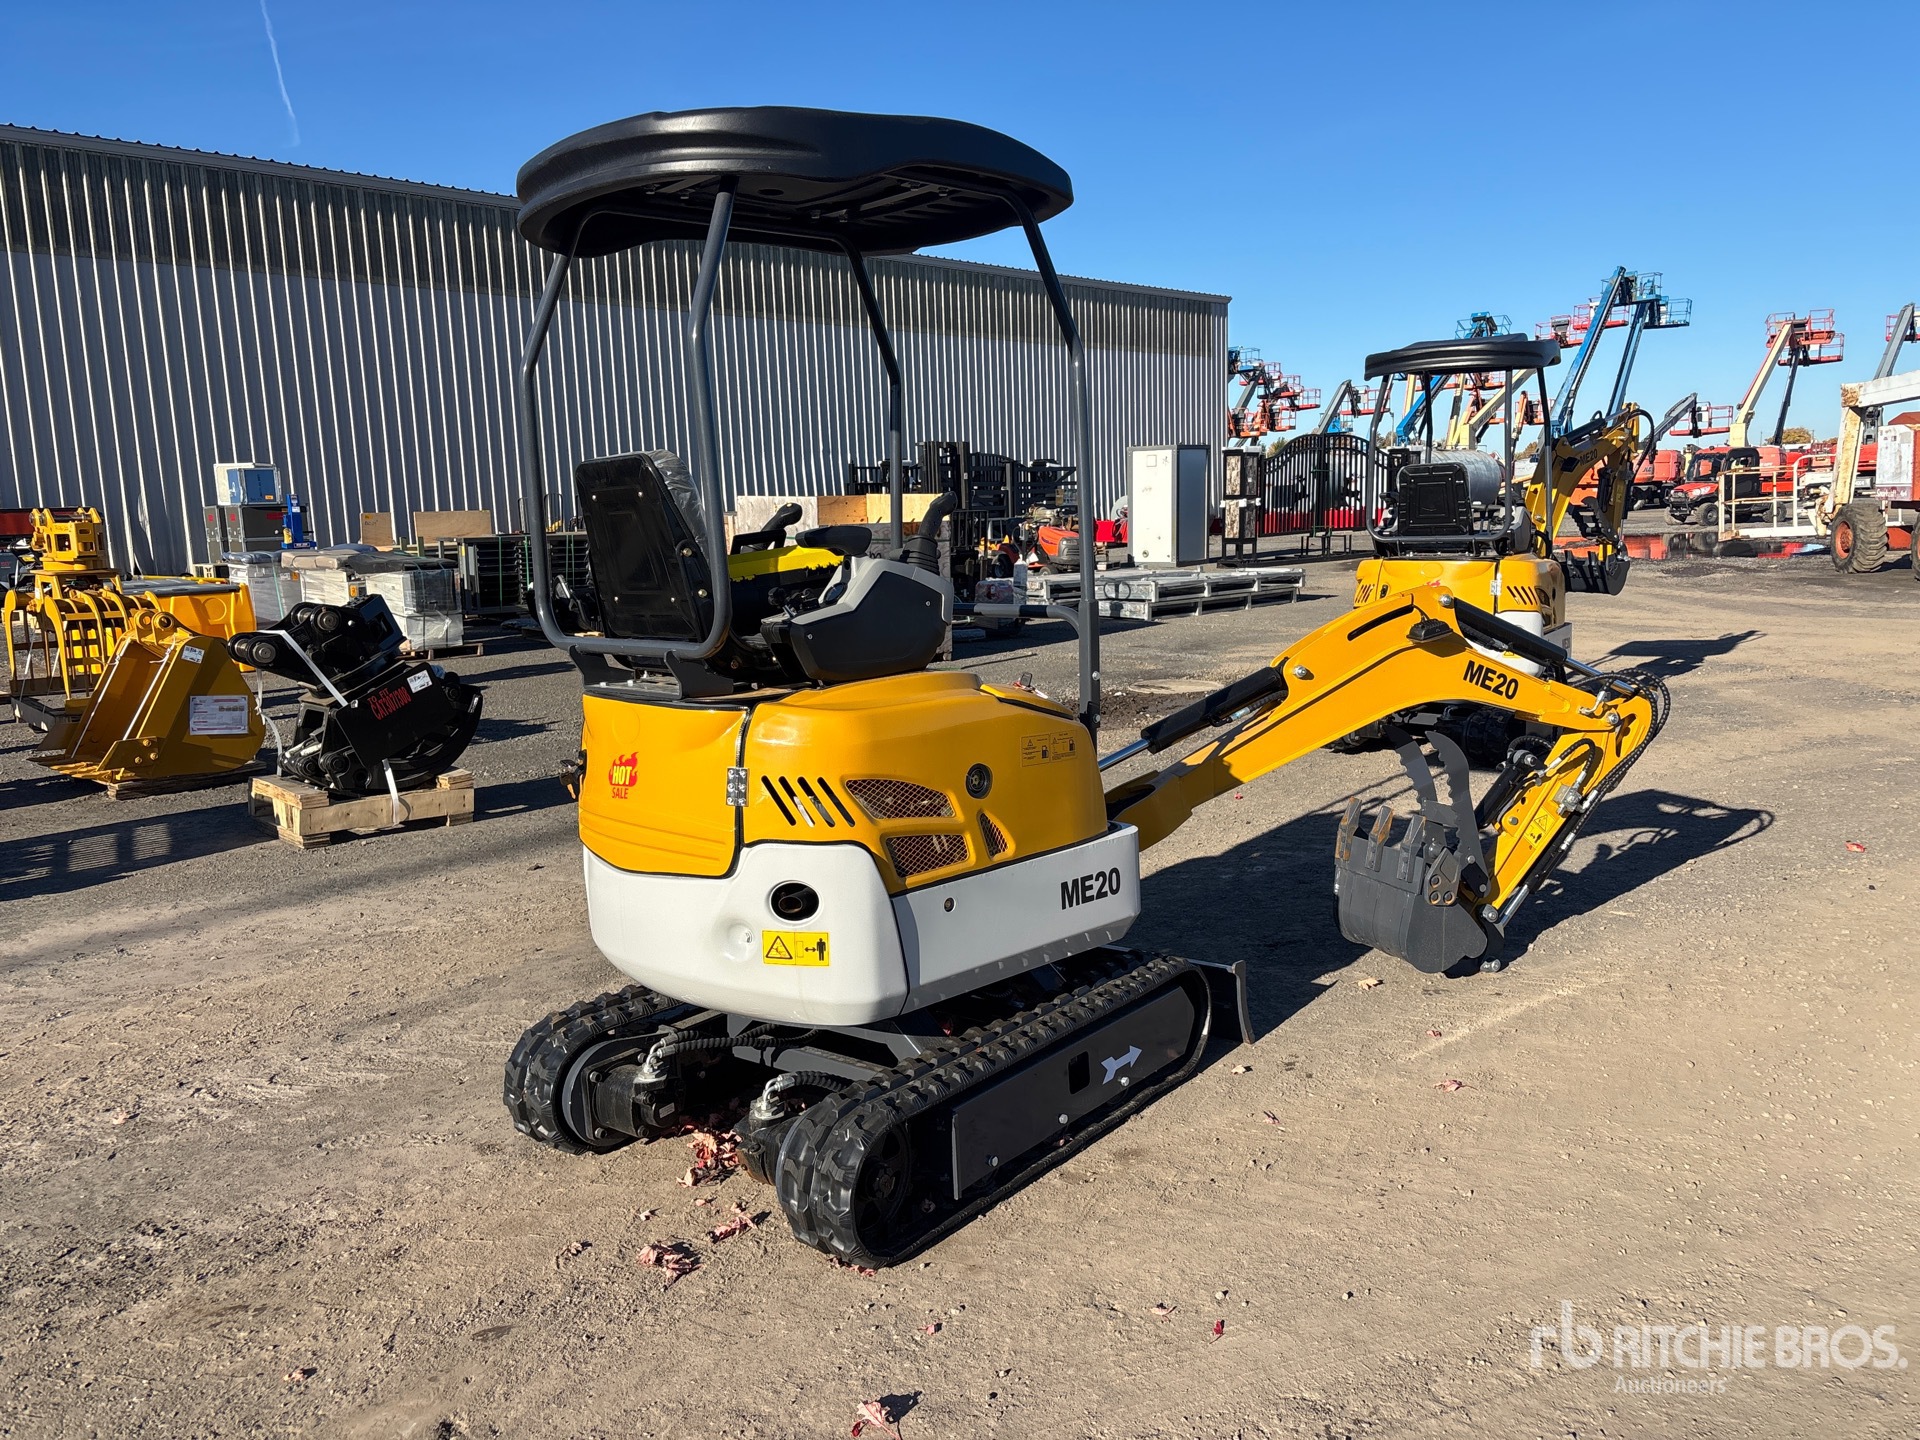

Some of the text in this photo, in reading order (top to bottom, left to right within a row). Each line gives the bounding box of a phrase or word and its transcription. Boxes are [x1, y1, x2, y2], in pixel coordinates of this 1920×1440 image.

[1463, 660, 1519, 700] ME20
[367, 688, 390, 705] TO FIT
[612, 765, 632, 785] HOT
[611, 787, 629, 799] SALE
[1060, 867, 1121, 910] ME20
